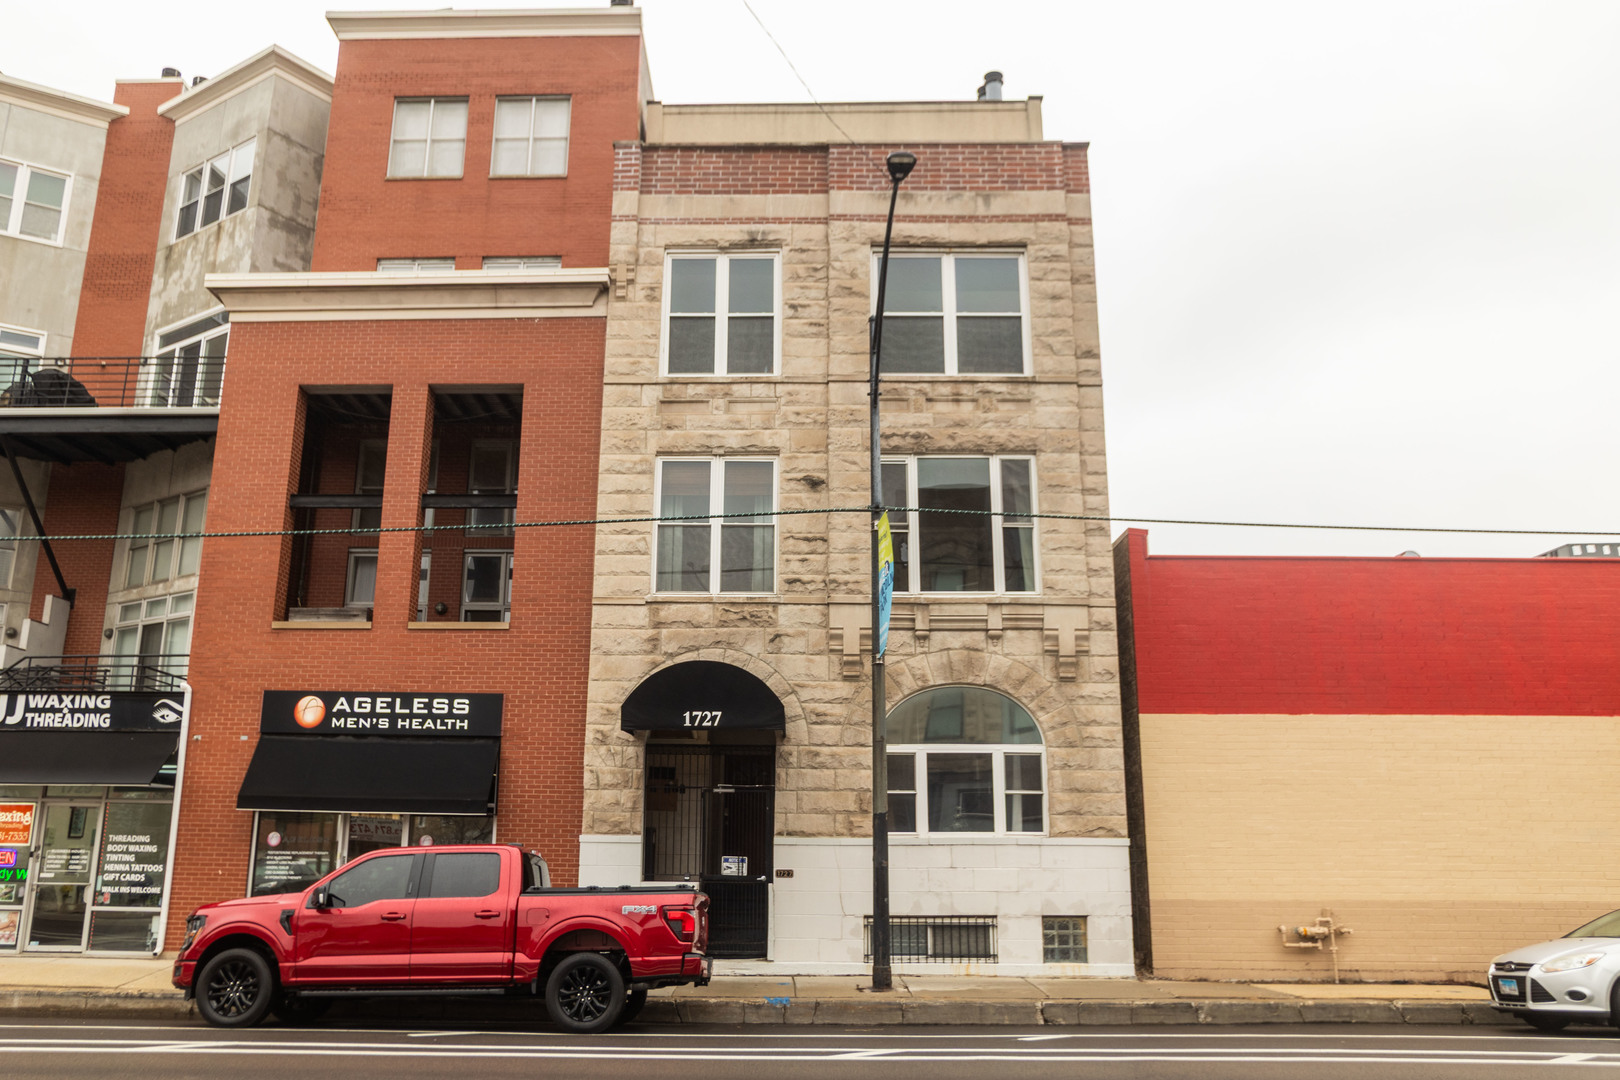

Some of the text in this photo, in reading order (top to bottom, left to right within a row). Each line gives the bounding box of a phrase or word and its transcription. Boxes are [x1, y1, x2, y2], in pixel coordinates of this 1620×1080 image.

[28, 694, 111, 709] WAXING
[332, 697, 470, 714] AGELESS
[25, 713, 111, 728] THREADING
[683, 711, 722, 726] 1727
[331, 717, 469, 730] MEN'S HEALTH
[109, 834, 151, 843] THREADING
[107, 844, 158, 853] BODY WAXING
[106, 853, 135, 862] TINTING
[104, 863, 164, 872] HENNA TATTOOS
[103, 873, 146, 882] GIFT CARDS
[131, 886, 161, 894] WELCOME
